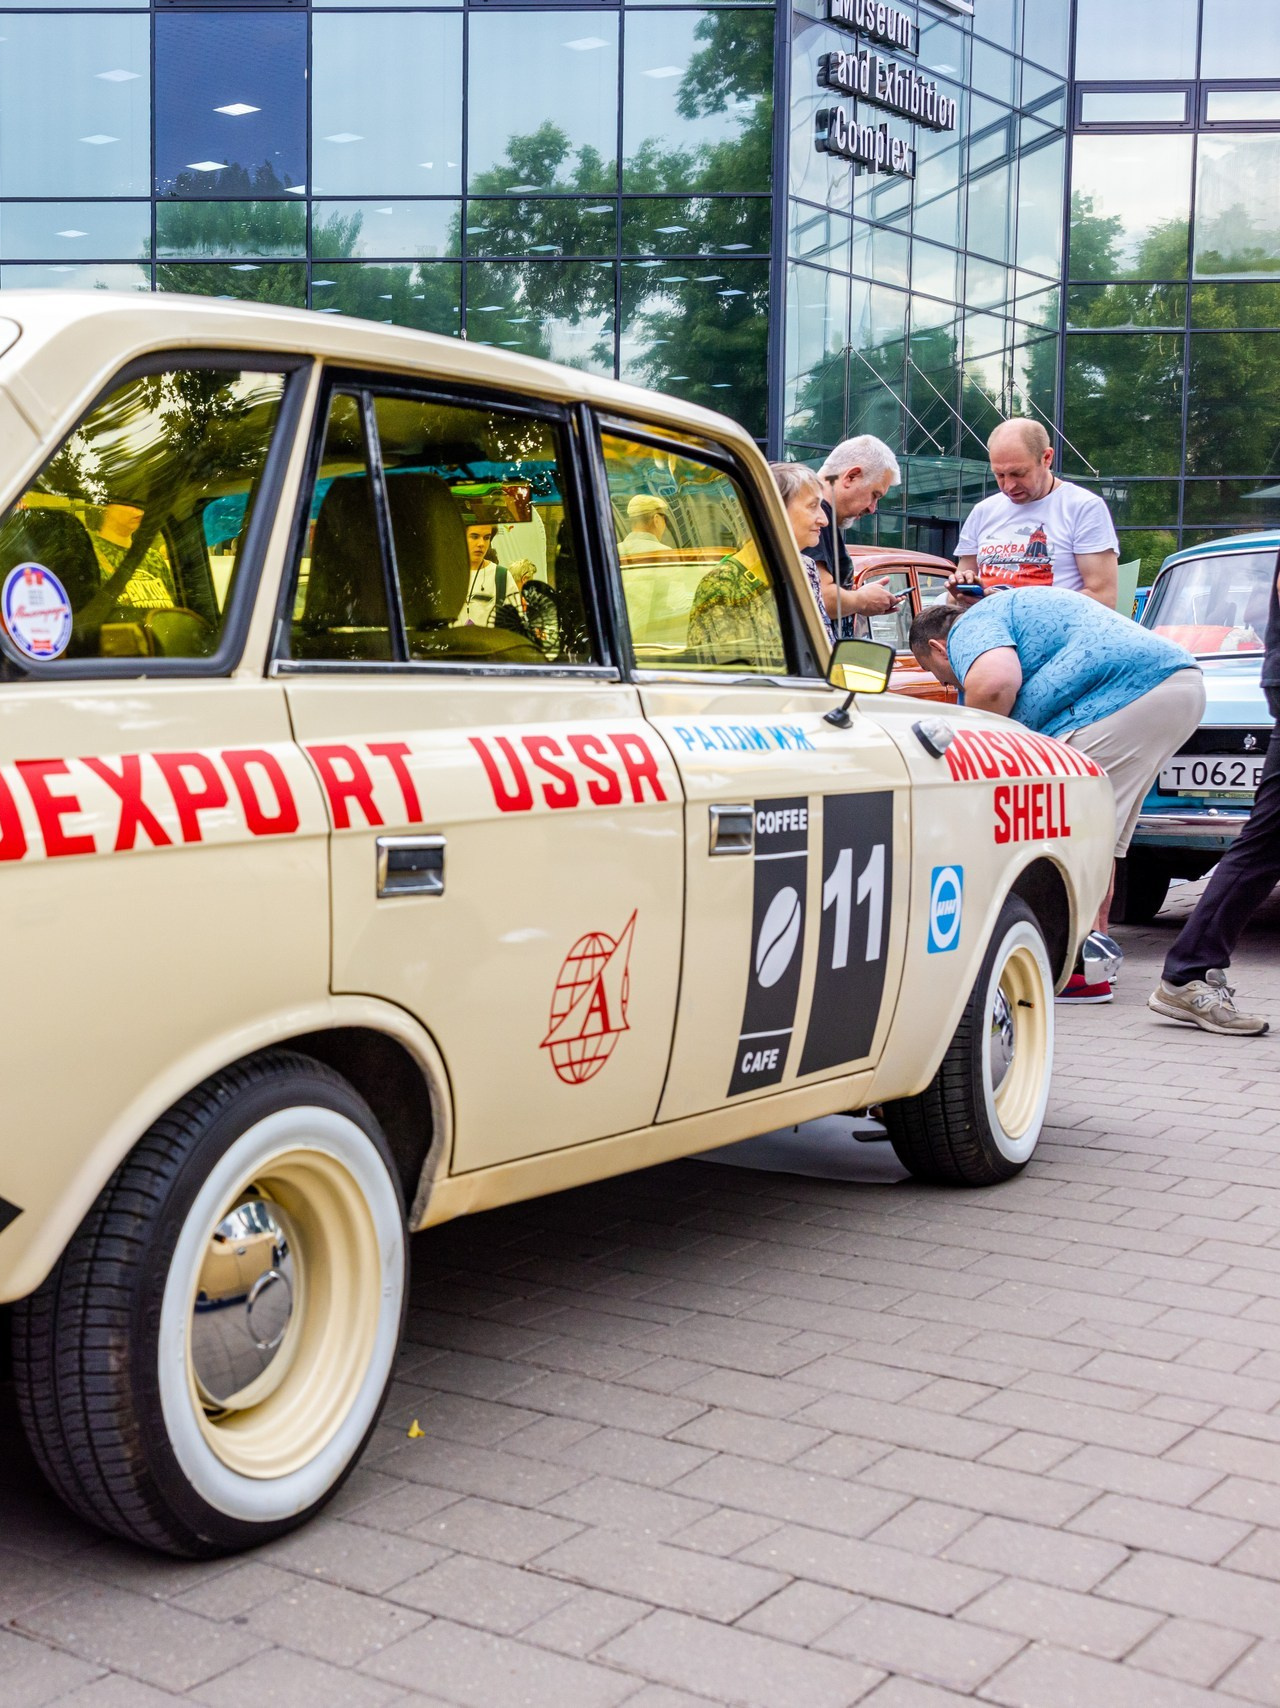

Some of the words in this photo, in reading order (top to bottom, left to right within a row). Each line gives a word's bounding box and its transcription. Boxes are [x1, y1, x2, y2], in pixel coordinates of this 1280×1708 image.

[837, 50, 871, 95] and
[876, 56, 957, 130] Exhibition
[835, 105, 910, 173] Complex
[980, 544, 1026, 555] МОСКВА
[468, 734, 669, 812] USSR
[756, 808, 808, 834] COFFEE
[994, 783, 1072, 844] SHELL
[823, 844, 886, 970] 11
[741, 1048, 780, 1074] CAFE
